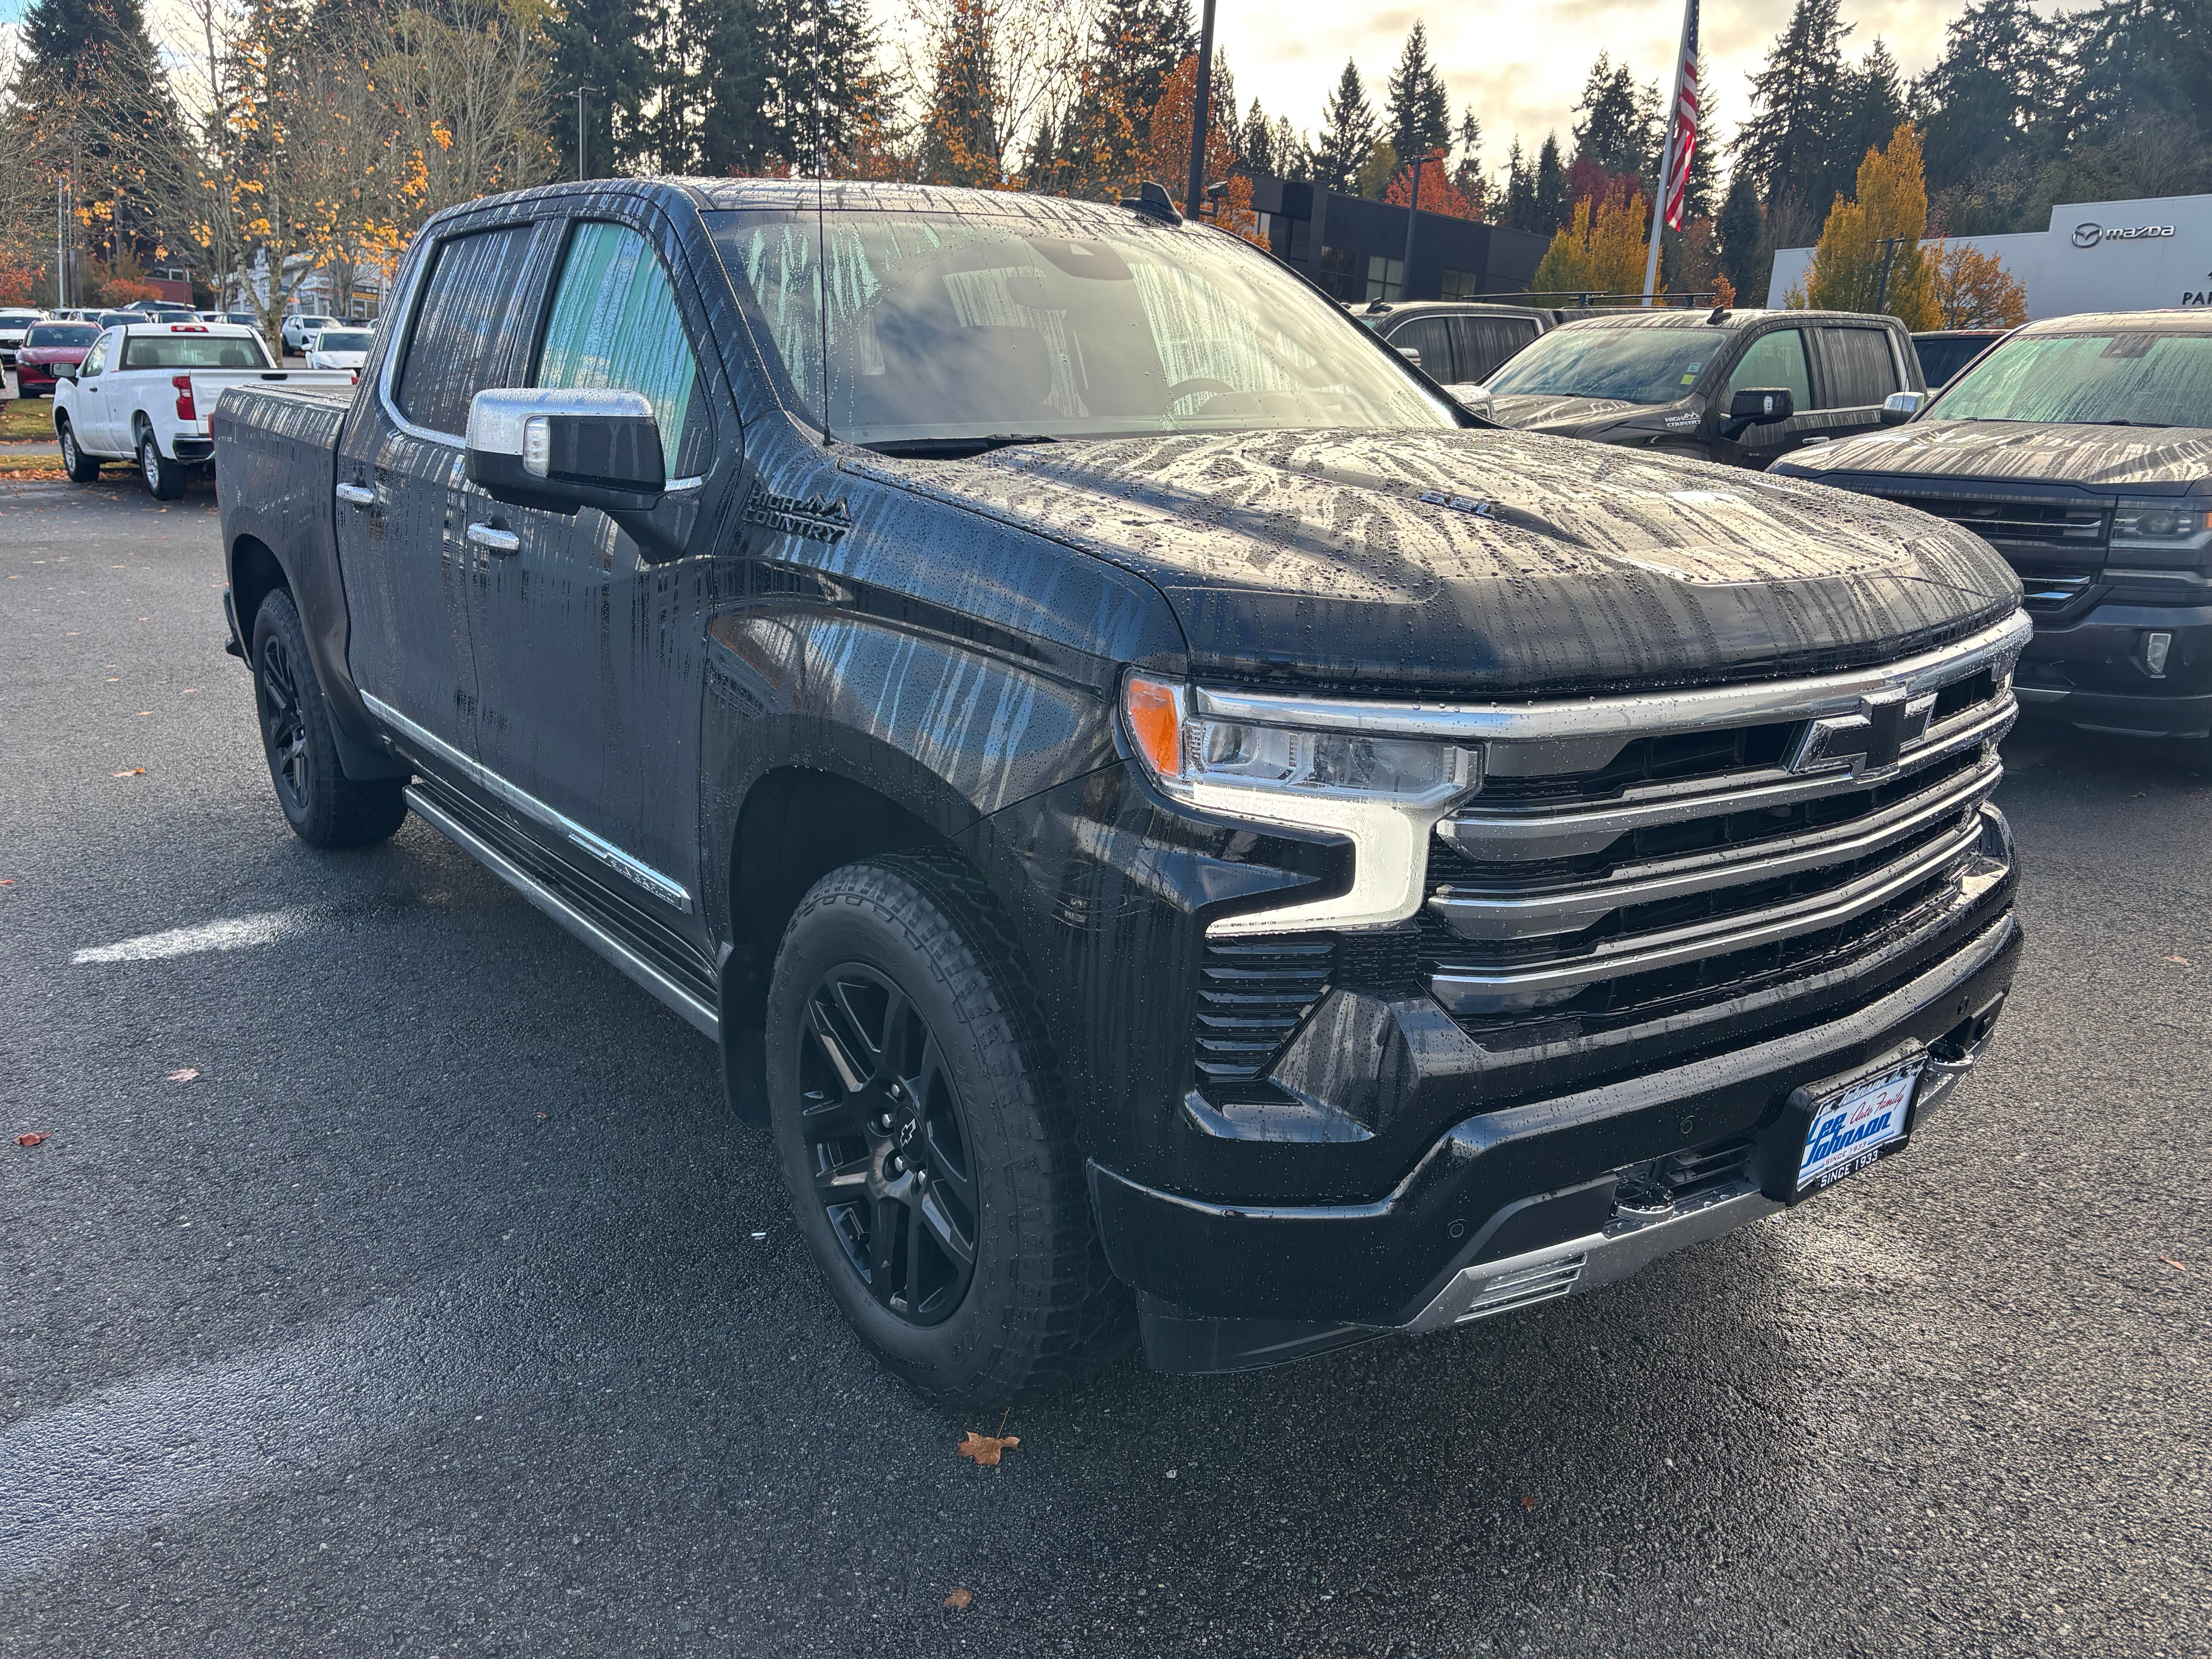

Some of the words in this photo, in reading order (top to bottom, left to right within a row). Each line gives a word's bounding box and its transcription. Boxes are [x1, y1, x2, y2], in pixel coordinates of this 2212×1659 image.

[1667, 419, 1701, 428] COUNTRY
[748, 490, 802, 513] HIGH
[742, 507, 846, 544] COUNTRY
[1850, 1101, 1873, 1125] Auto
[1874, 1084, 1906, 1115] Family
[1801, 1111, 1892, 1169] Johnson
[1806, 1112, 1848, 1146] Lee
[1820, 1163, 1851, 1187] SINCE
[1855, 1149, 1878, 1170] 1933
[1825, 1151, 1847, 1165] SINCE
[1850, 1141, 1867, 1155] 1933
